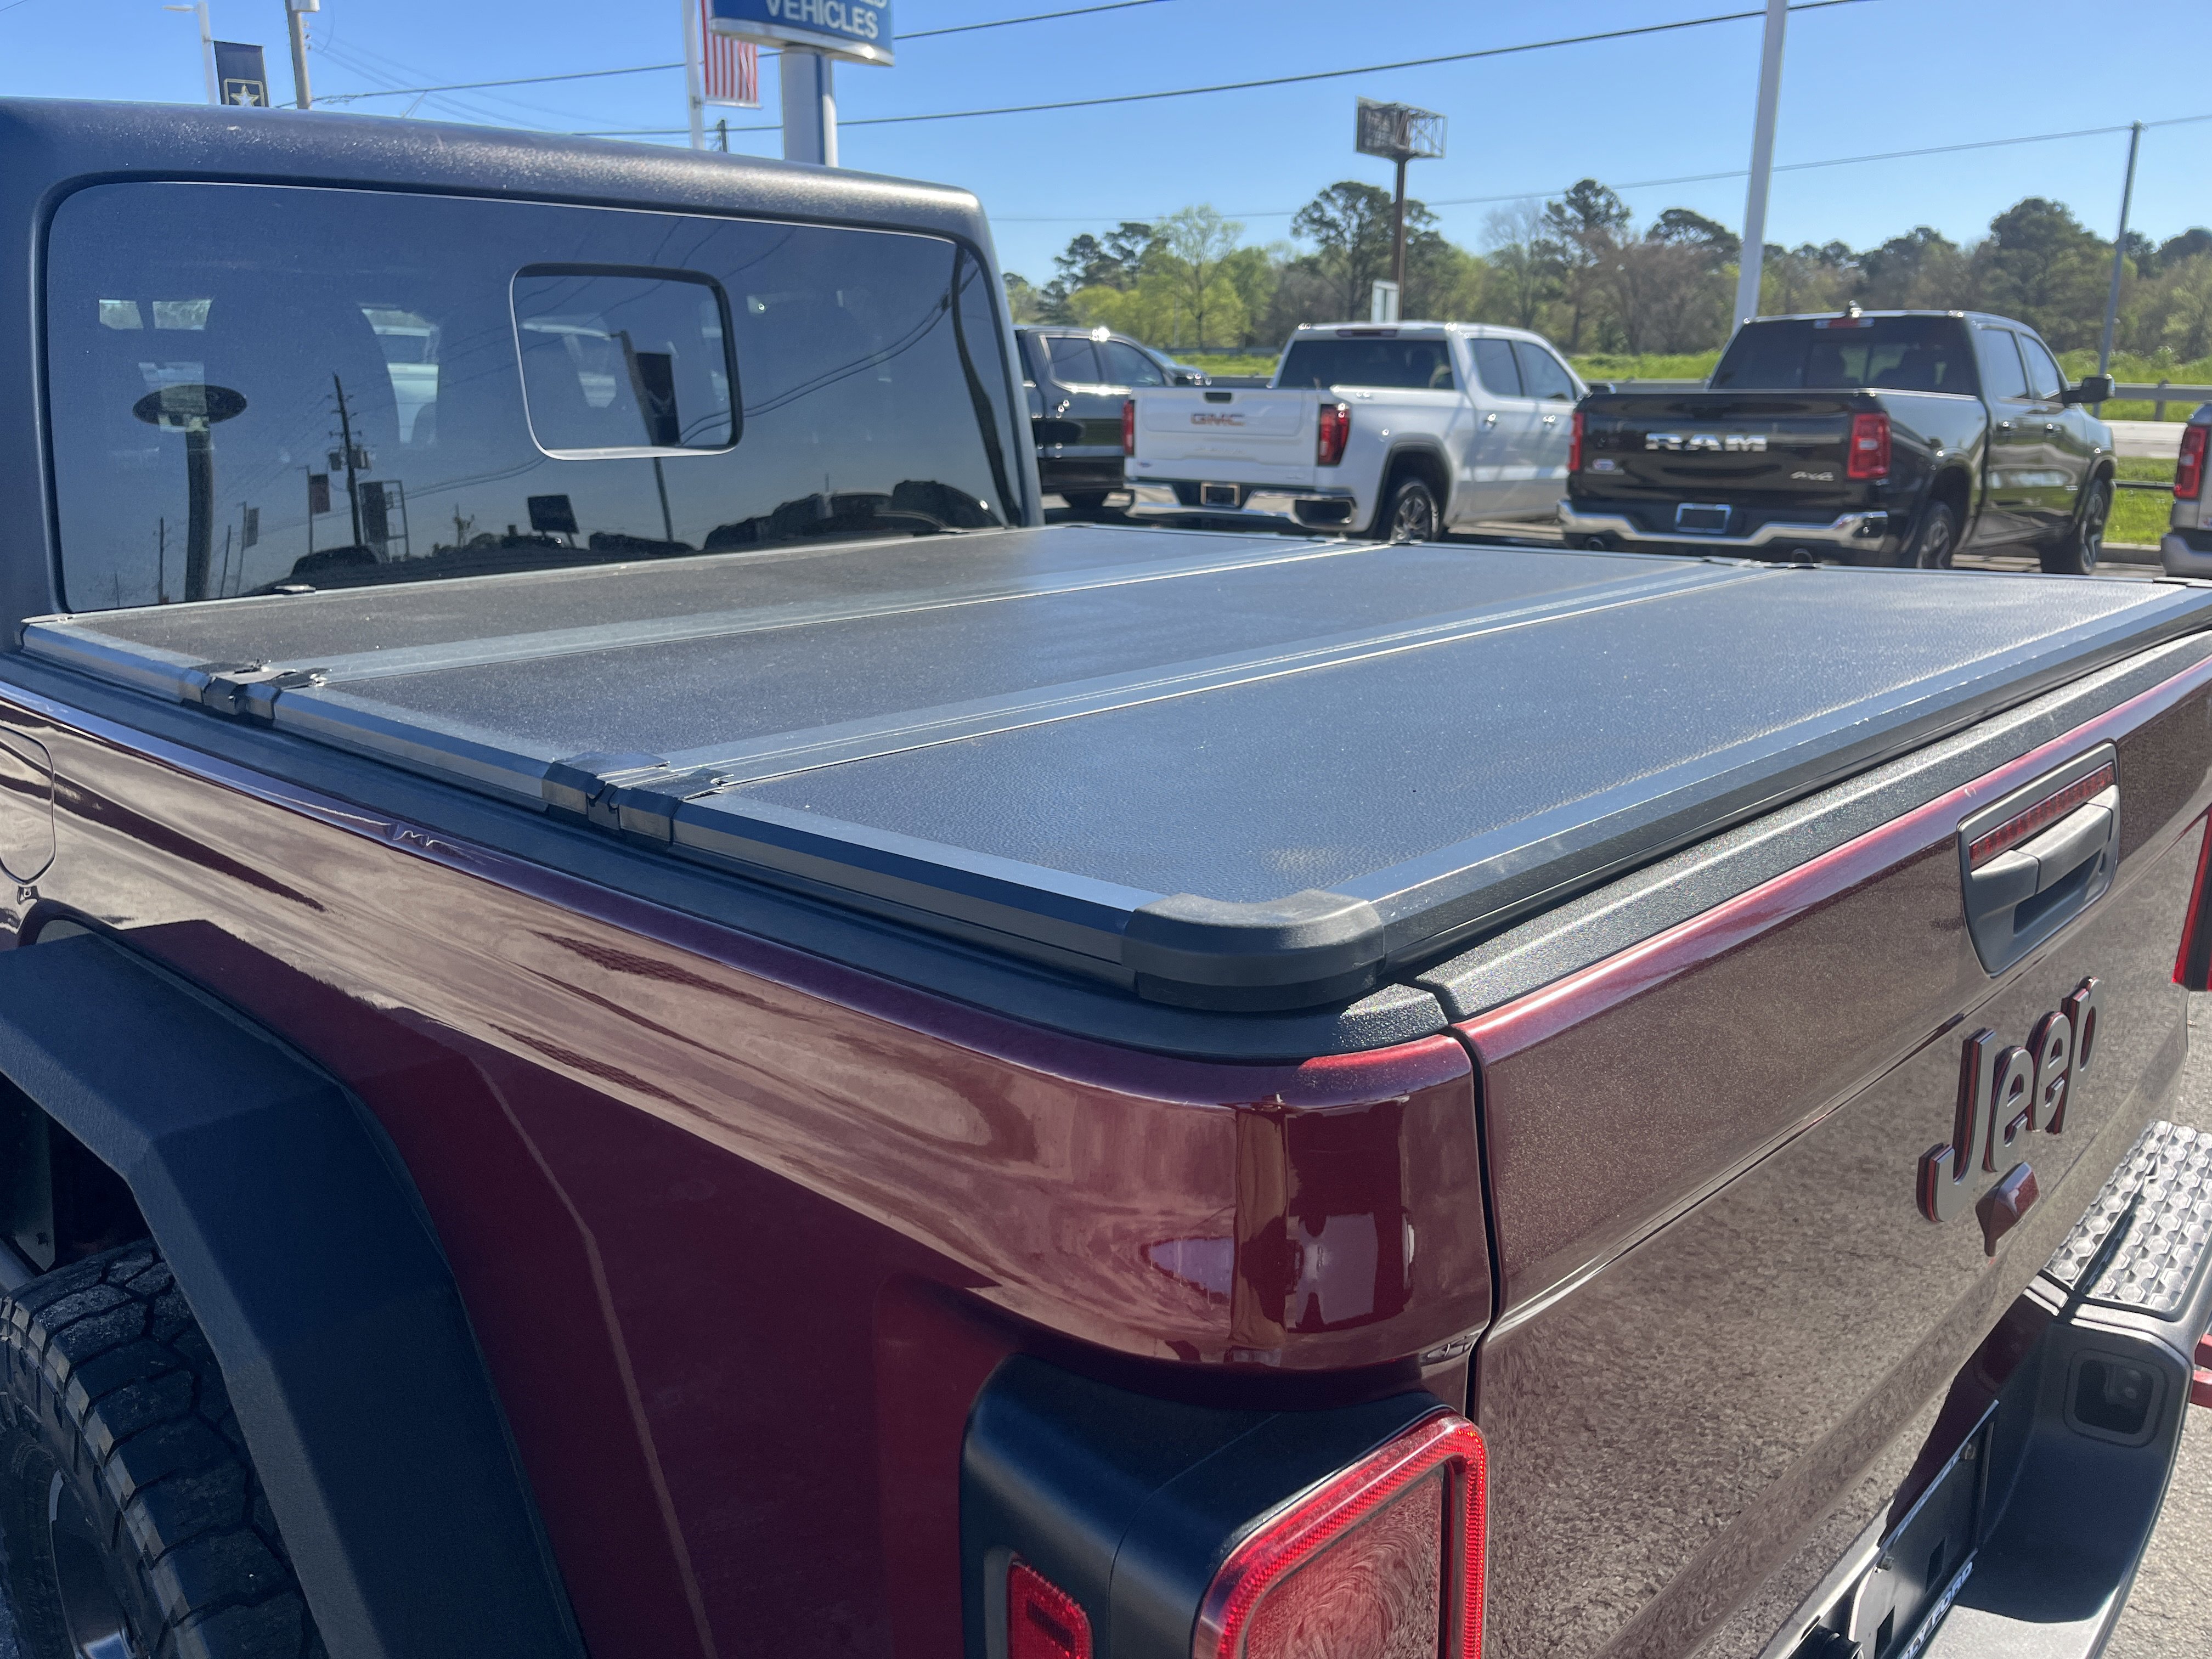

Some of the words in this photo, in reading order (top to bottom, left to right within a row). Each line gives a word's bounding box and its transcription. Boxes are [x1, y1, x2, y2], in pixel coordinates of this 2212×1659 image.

[767, 0, 878, 40] VEHICLES
[1190, 413, 1245, 426] GMC
[1645, 434, 1767, 452] RAM
[1916, 976, 2104, 1222] Jeep
[1932, 1562, 1973, 1626] FORD
